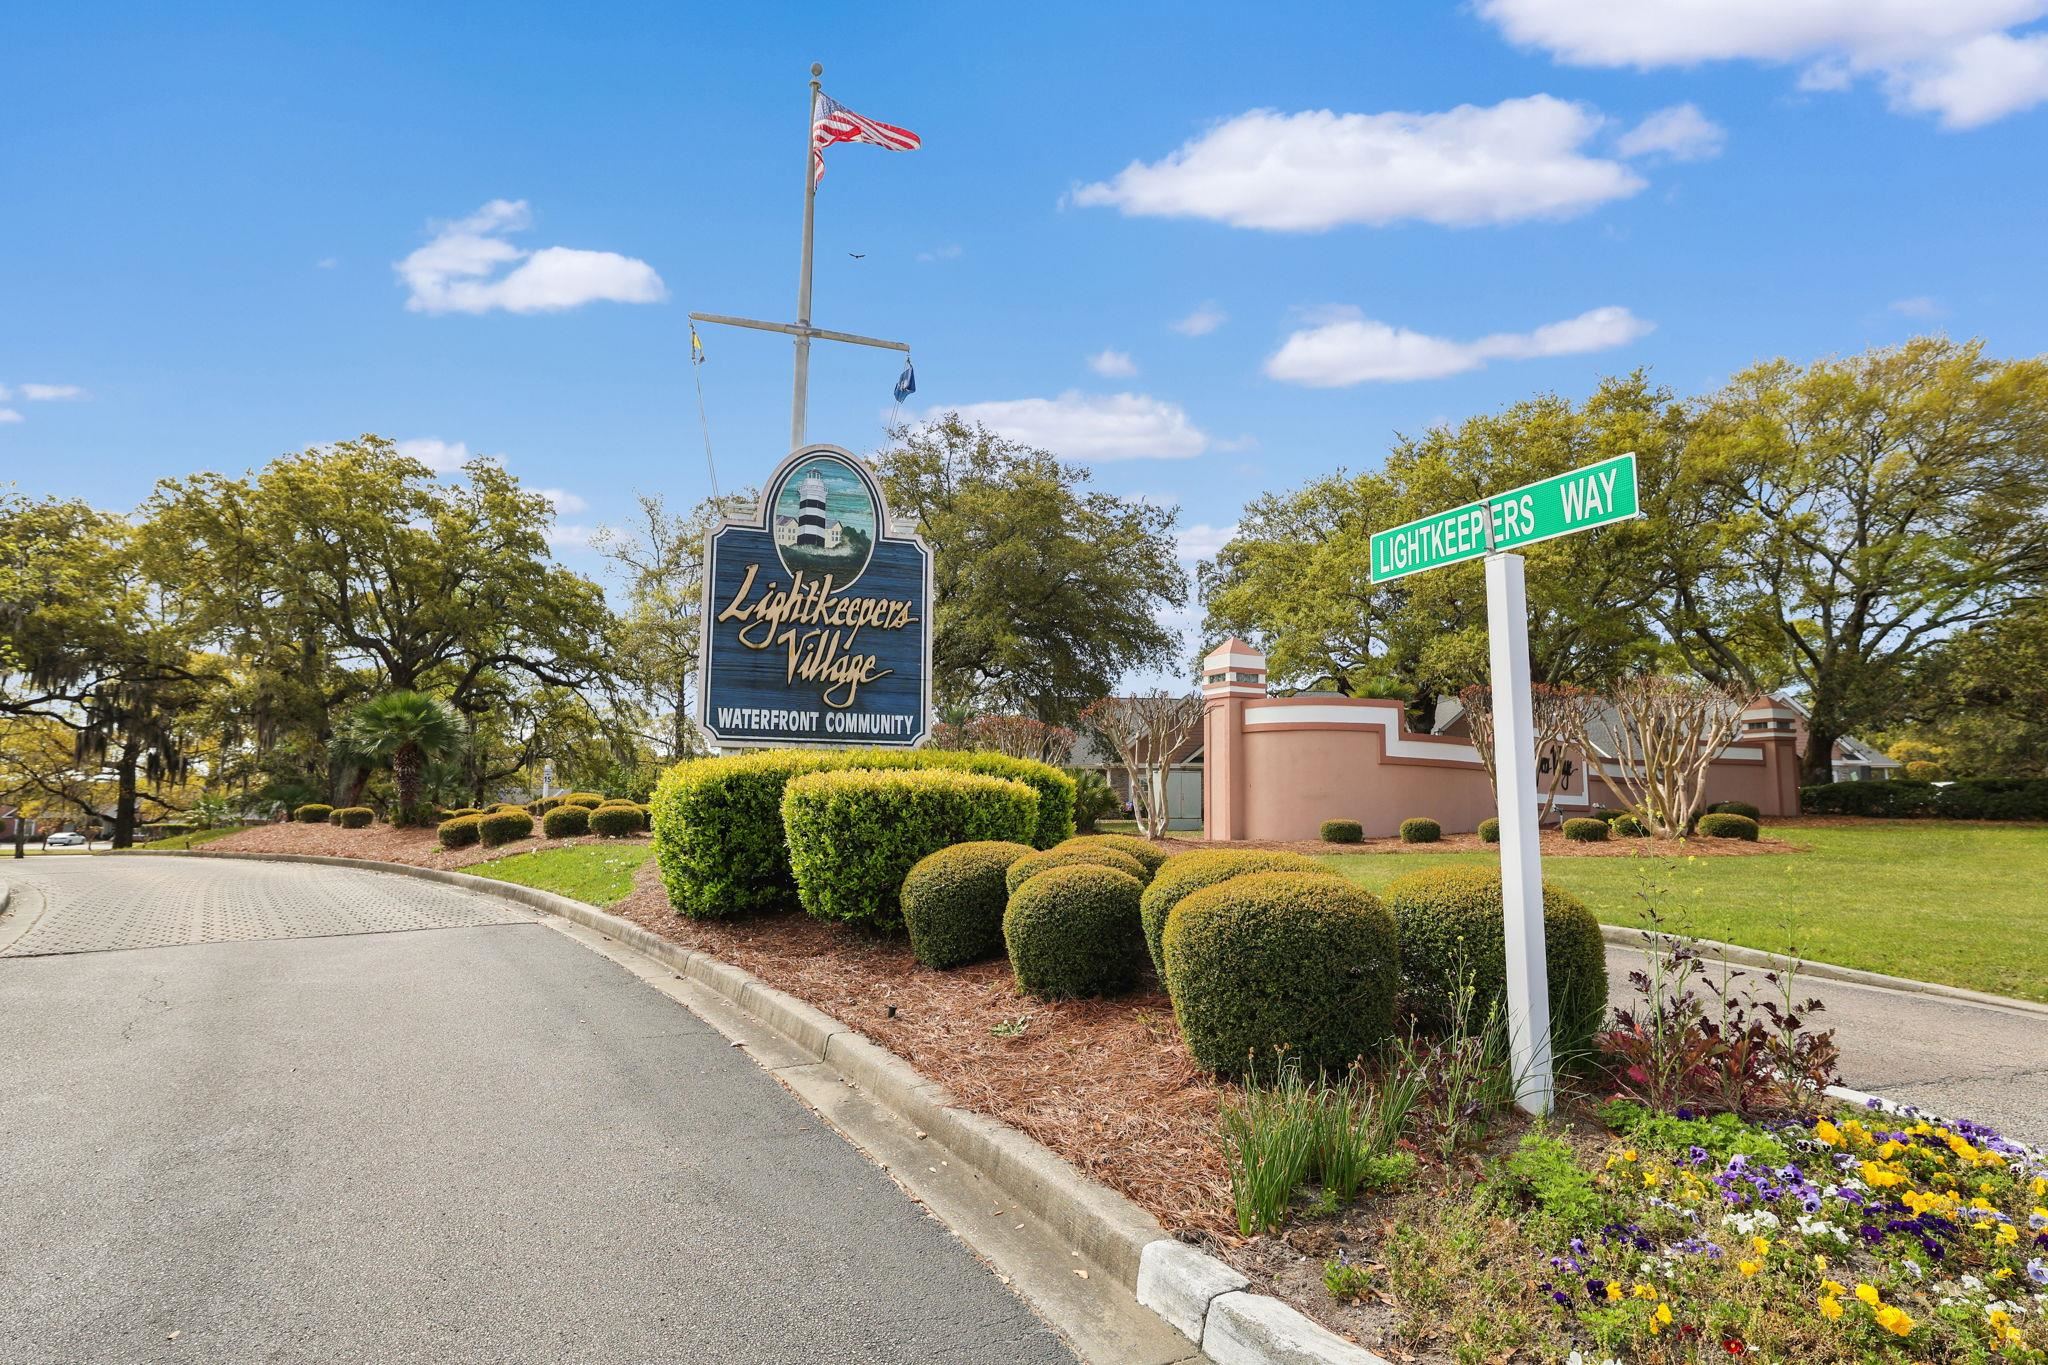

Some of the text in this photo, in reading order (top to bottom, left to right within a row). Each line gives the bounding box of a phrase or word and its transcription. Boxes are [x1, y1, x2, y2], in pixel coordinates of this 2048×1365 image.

[1379, 468, 1617, 574] LIGHTKEEPERS WAY
[718, 563, 919, 650] Lightkeepers
[777, 627, 893, 709] Village
[717, 707, 914, 735] WATERFRONT COMMUNITY
